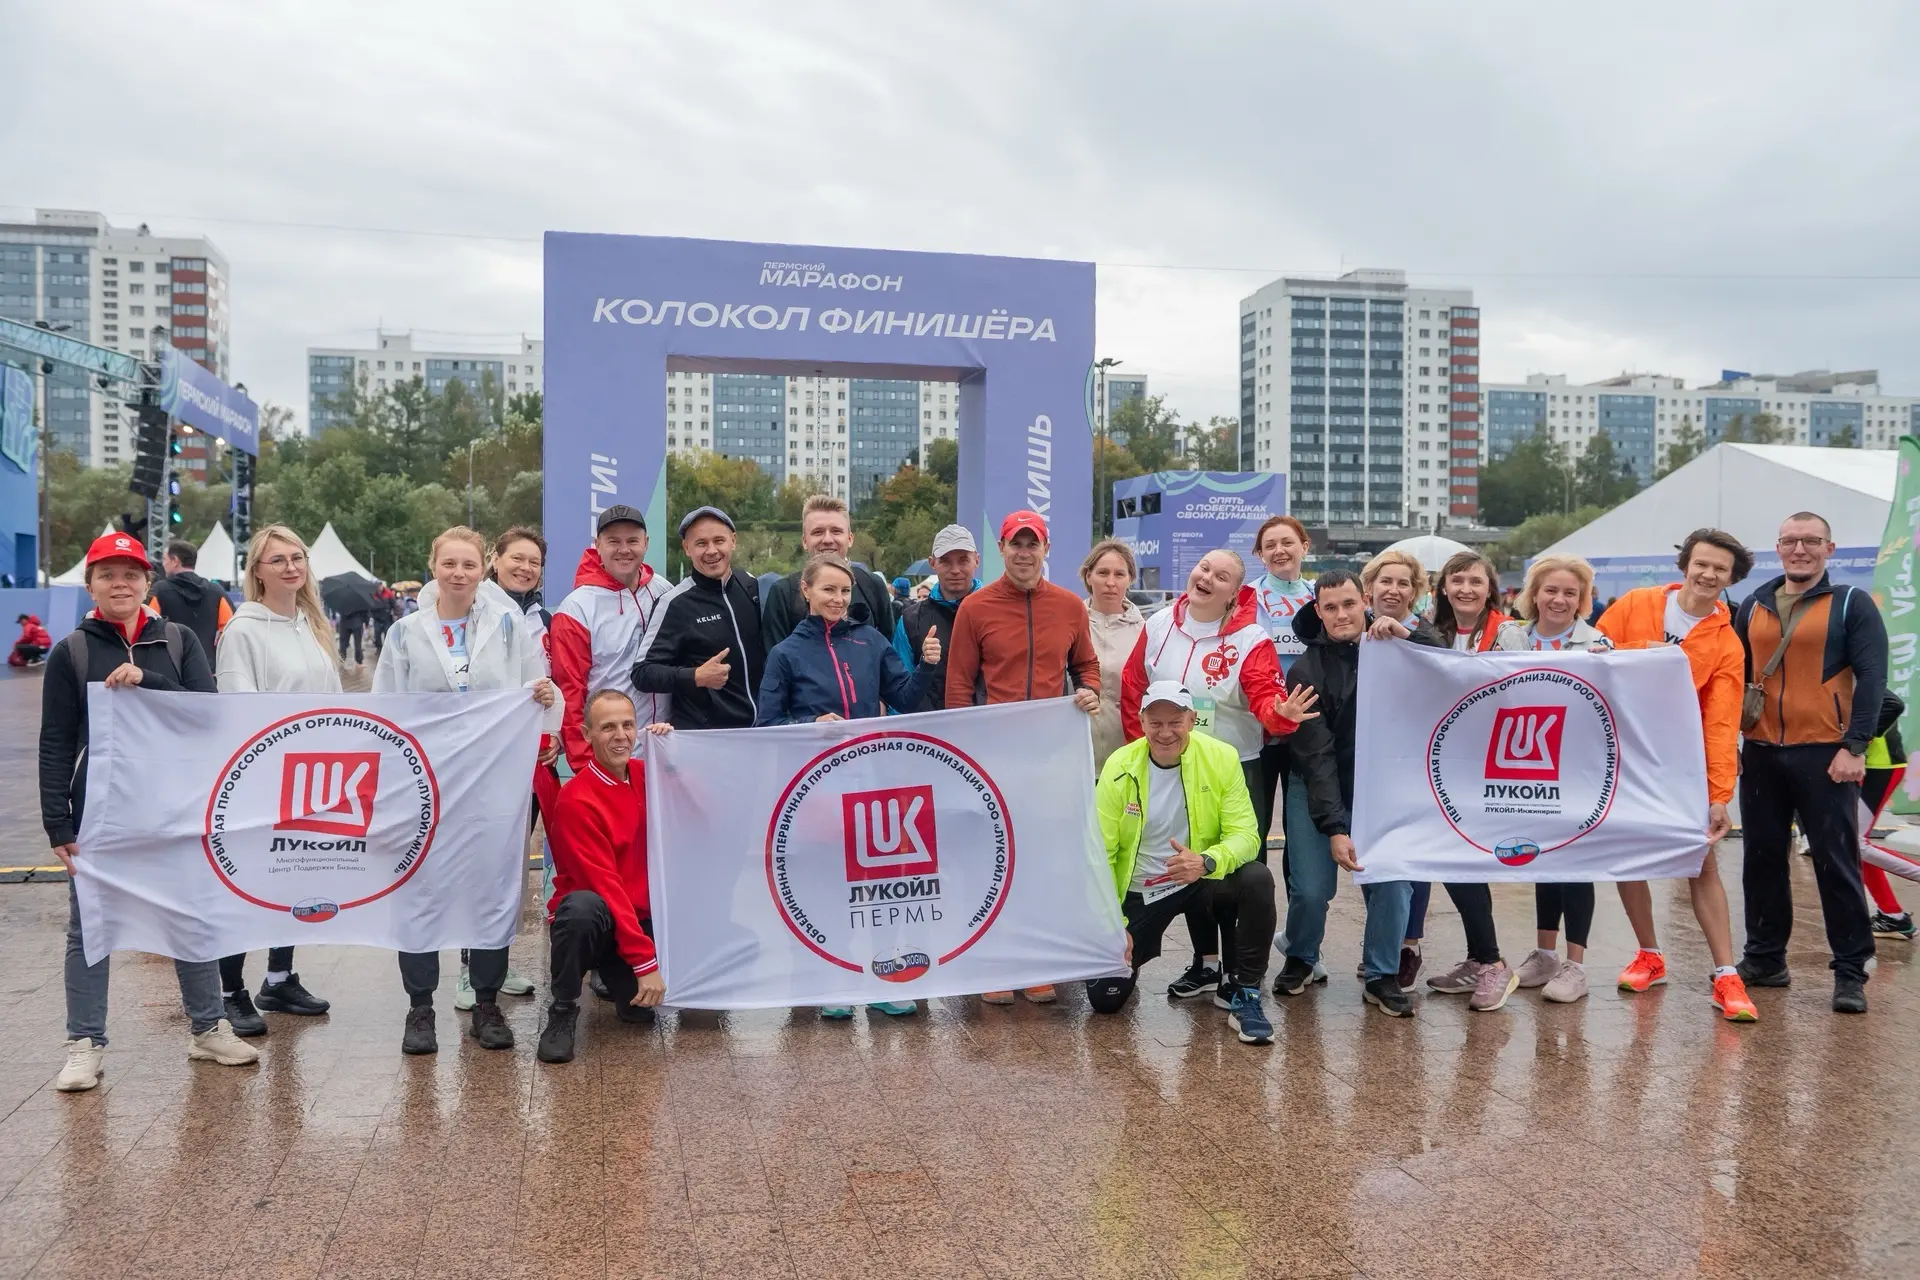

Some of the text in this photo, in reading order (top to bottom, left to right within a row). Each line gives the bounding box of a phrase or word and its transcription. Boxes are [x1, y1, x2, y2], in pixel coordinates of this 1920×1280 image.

[764, 261, 826, 272] ПЕРМСКИЙ
[759, 269, 903, 292] МАРАФОН
[592, 298, 1057, 342] КОЛОКОЛ ФИНИШЁРА
[1196, 504, 1267, 512] ПОБЕГУШКАХ
[1209, 496, 1244, 504] ОПЯТЬ
[609, 506, 630, 519] 17
[1176, 511, 1215, 519] СВОИХ
[696, 613, 722, 623] KELME
[1499, 673, 1573, 692] ОРГАНИЗАЦИЯ
[1573, 682, 1595, 701] ООО
[1432, 686, 1497, 756] ПРОФСОЮЗНАЯ
[217, 723, 302, 809] ПРОФСОЮЗНАЯ
[305, 717, 405, 749] ОРГАНИЗАЦИЯ
[403, 748, 422, 775] ООО
[1432, 758, 1462, 823] ПЕРВИЧНАЯ
[1484, 783, 1560, 800] ЛУКОЙЛ
[776, 742, 1007, 944] ОБЪЕДИНЕННАЯ ПЕРВИЧНАЯ ПРОФСОЮЗНАЯ ОРГАНИЗАЦИЯ ООО «ЛУКОЙЛ-ПЕРМЬ»
[276, 857, 359, 865] Многофункциональный
[294, 864, 334, 872] Поддержки
[337, 864, 366, 872] Бизнеса
[849, 876, 940, 904] ЛУКОЙЛ
[850, 903, 943, 928] ПЕРМЬ
[874, 962, 894, 974] НГСП
